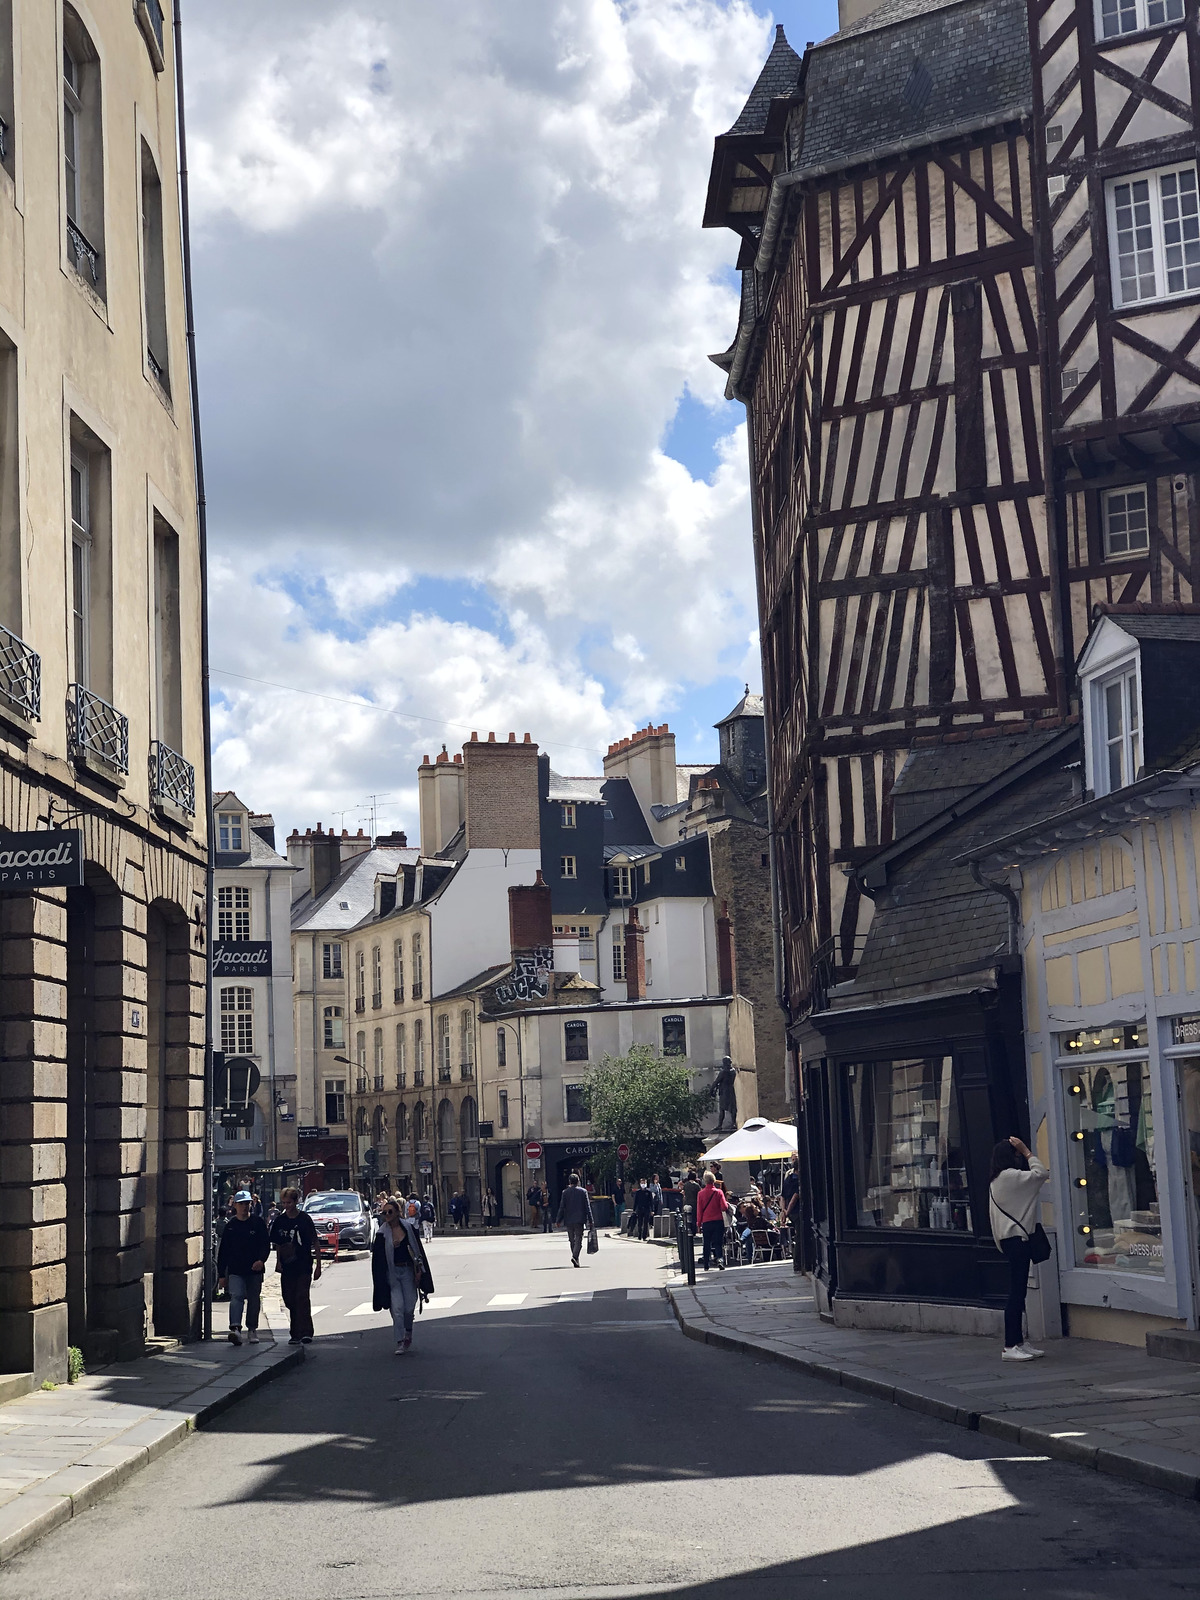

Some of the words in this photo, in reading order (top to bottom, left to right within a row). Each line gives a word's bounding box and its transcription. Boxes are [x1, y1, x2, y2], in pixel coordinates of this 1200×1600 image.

[0, 841, 73, 868] acadi
[1, 869, 56, 881] PARIS
[213, 944, 268, 971] jacadi
[224, 965, 258, 973] PARIS
[565, 1146, 599, 1154] CAROLL
